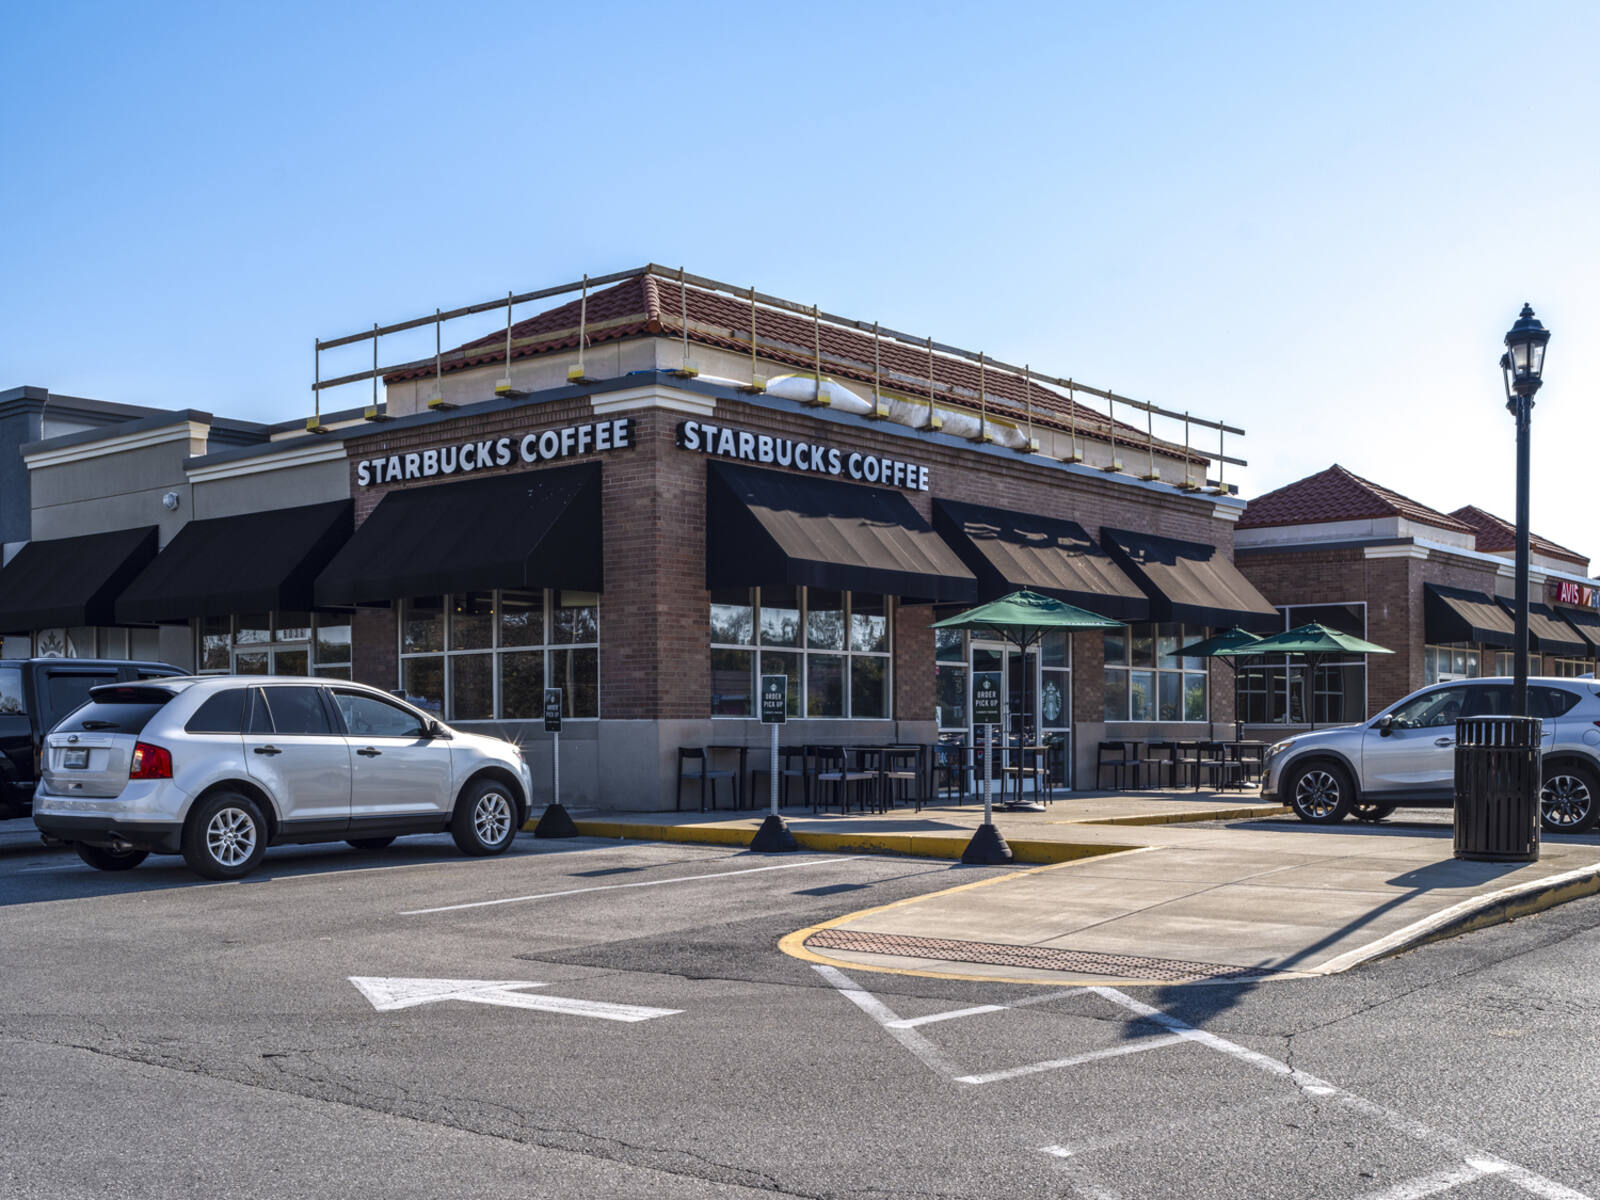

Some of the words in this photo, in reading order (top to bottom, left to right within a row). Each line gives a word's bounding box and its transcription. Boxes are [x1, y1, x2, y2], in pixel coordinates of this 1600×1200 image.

[357, 438, 511, 487] STARBUCKS
[520, 418, 629, 463] COFFEE
[683, 420, 841, 475] STARBUCKS
[849, 452, 929, 491] COFFEE
[1560, 581, 1579, 605] AVIS
[763, 700, 775, 708] PICK
[975, 699, 989, 707] PICK
